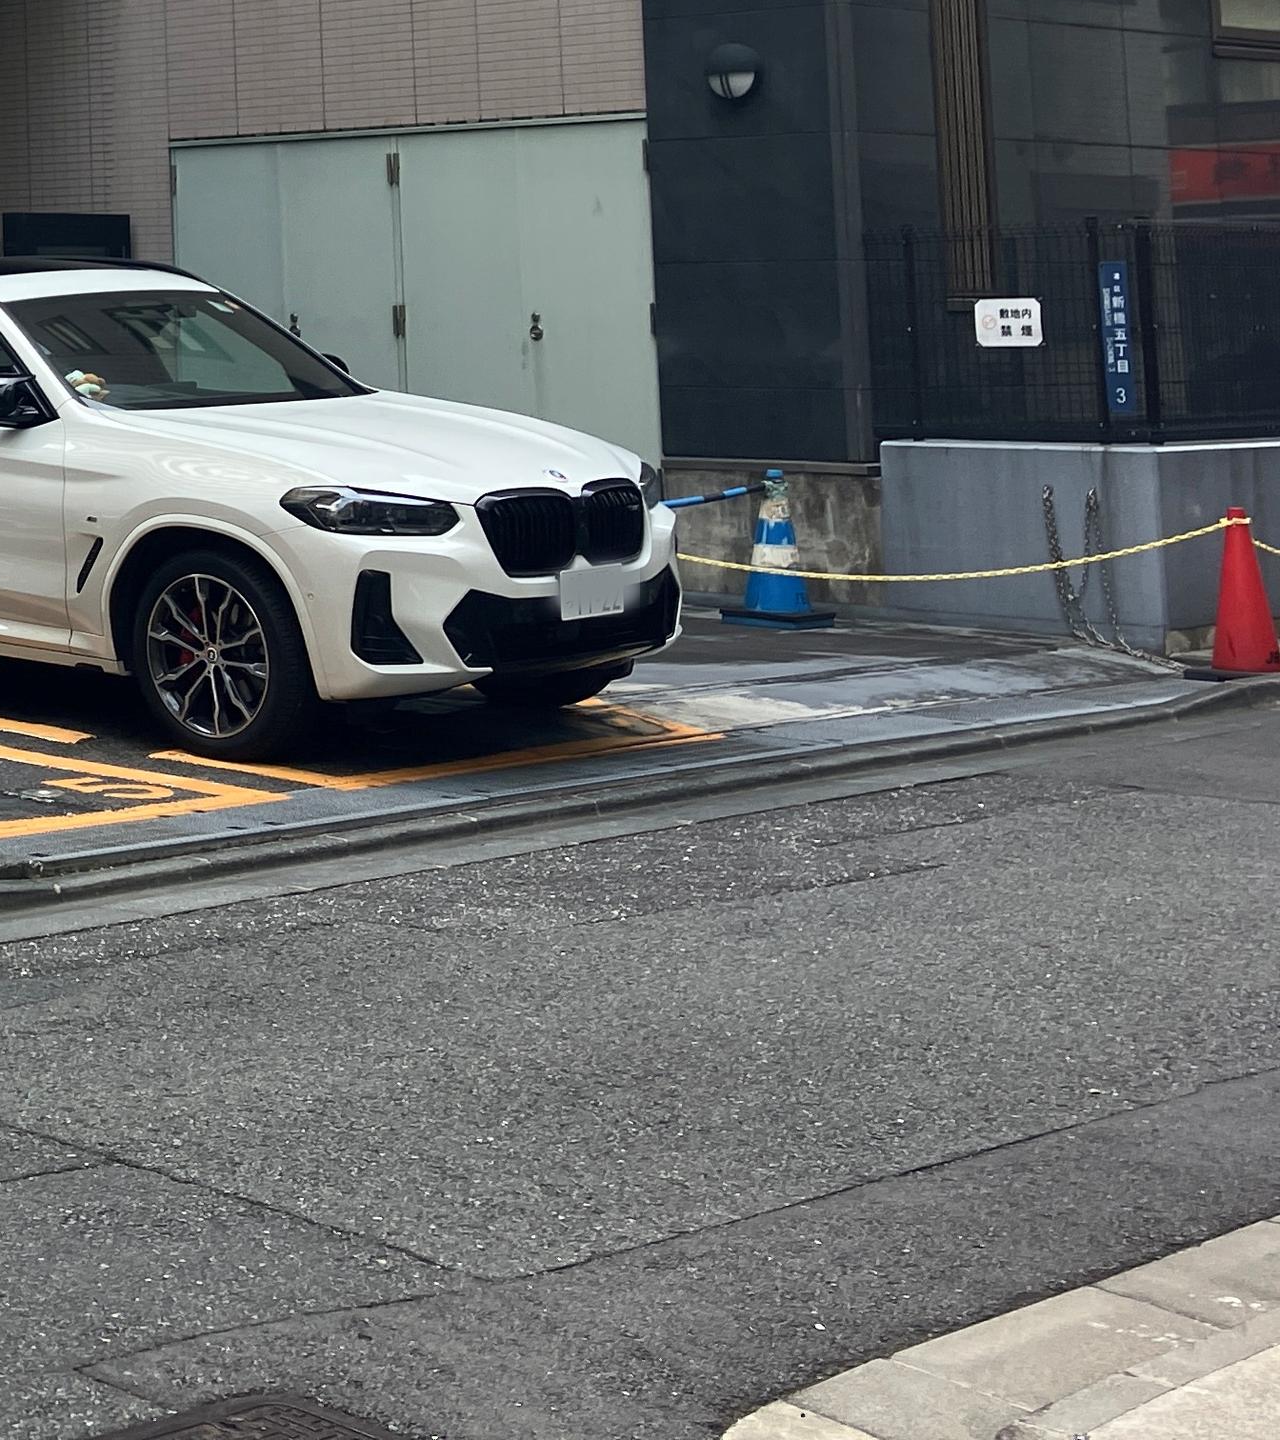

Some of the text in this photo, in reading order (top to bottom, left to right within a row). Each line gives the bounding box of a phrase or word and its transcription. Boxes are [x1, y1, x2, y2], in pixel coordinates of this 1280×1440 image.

[1112, 295, 1129, 374] 新橋五丁目
[1115, 387, 1127, 404] 3
